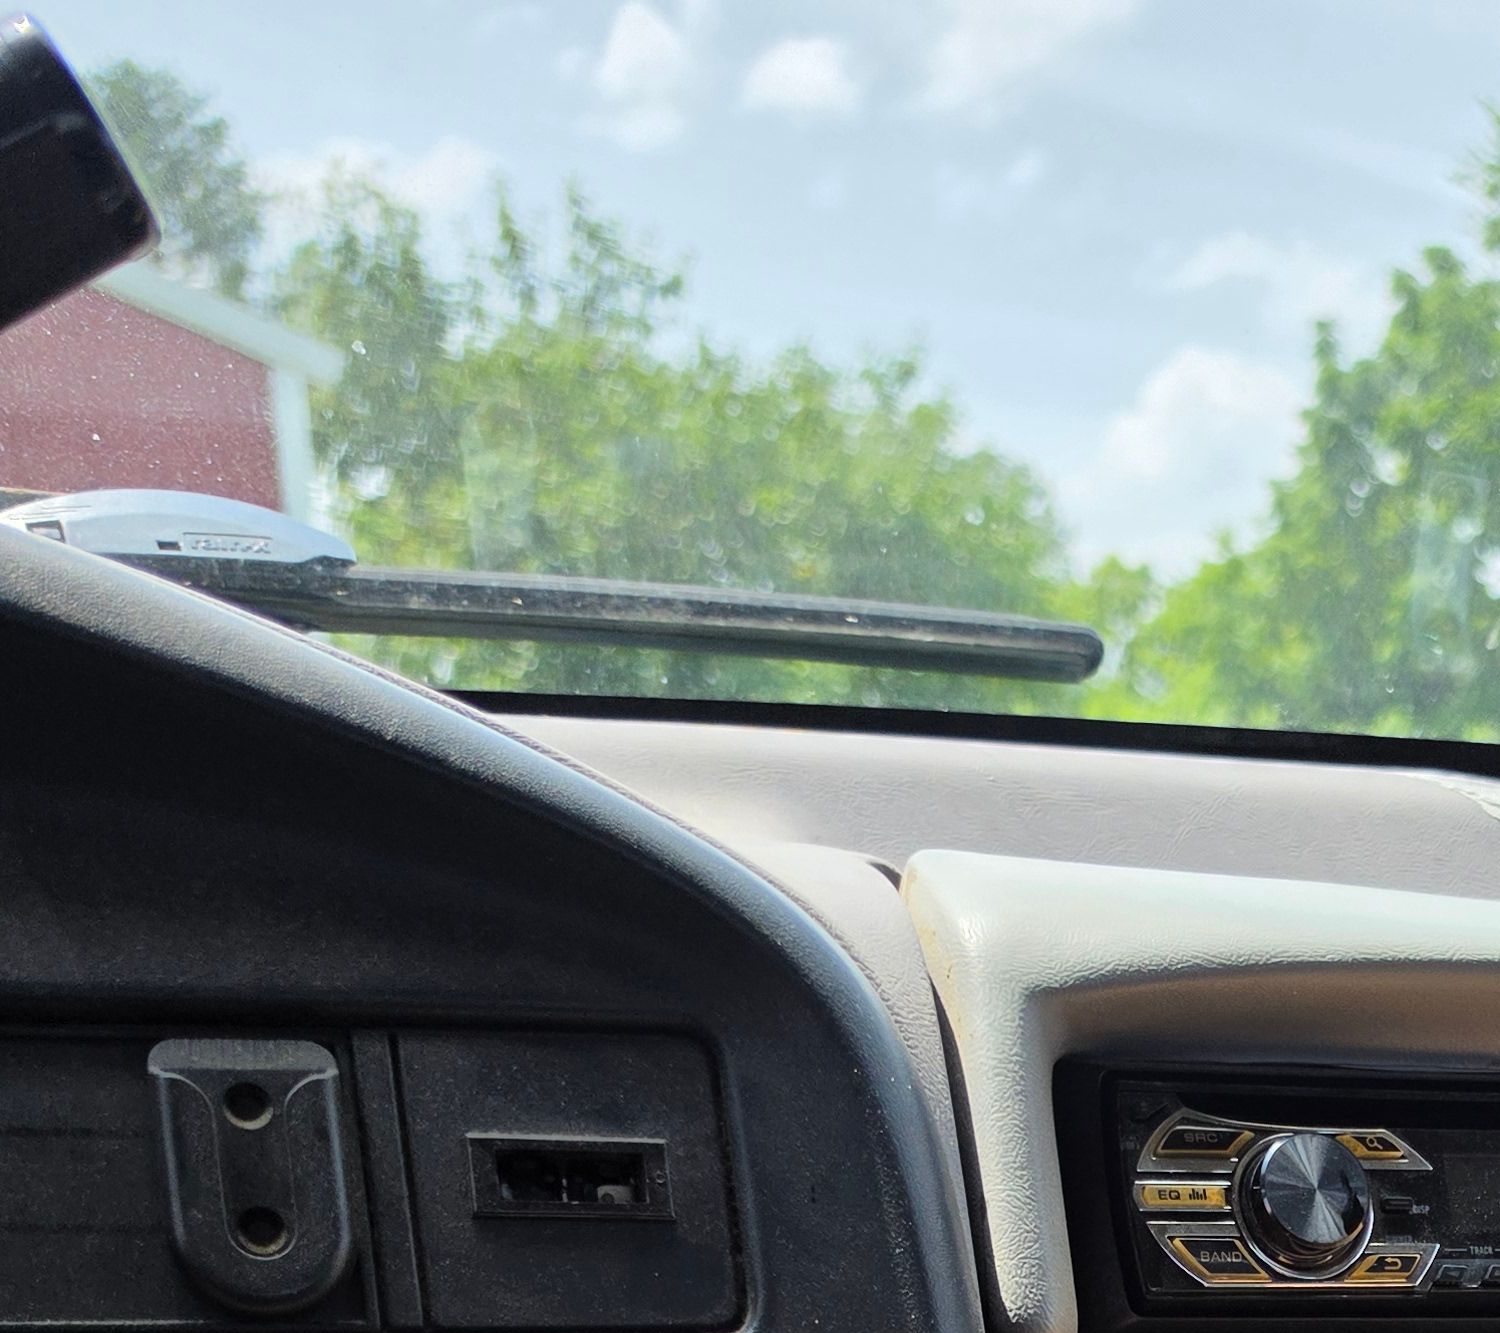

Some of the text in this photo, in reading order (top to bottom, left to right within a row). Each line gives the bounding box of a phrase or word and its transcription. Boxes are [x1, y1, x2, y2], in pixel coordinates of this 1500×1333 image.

[1183, 1132, 1218, 1143] SRC
[1157, 1189, 1181, 1201] EQ
[1200, 1249, 1243, 1263] BAND
[1470, 1246, 1493, 1255] TRACK
